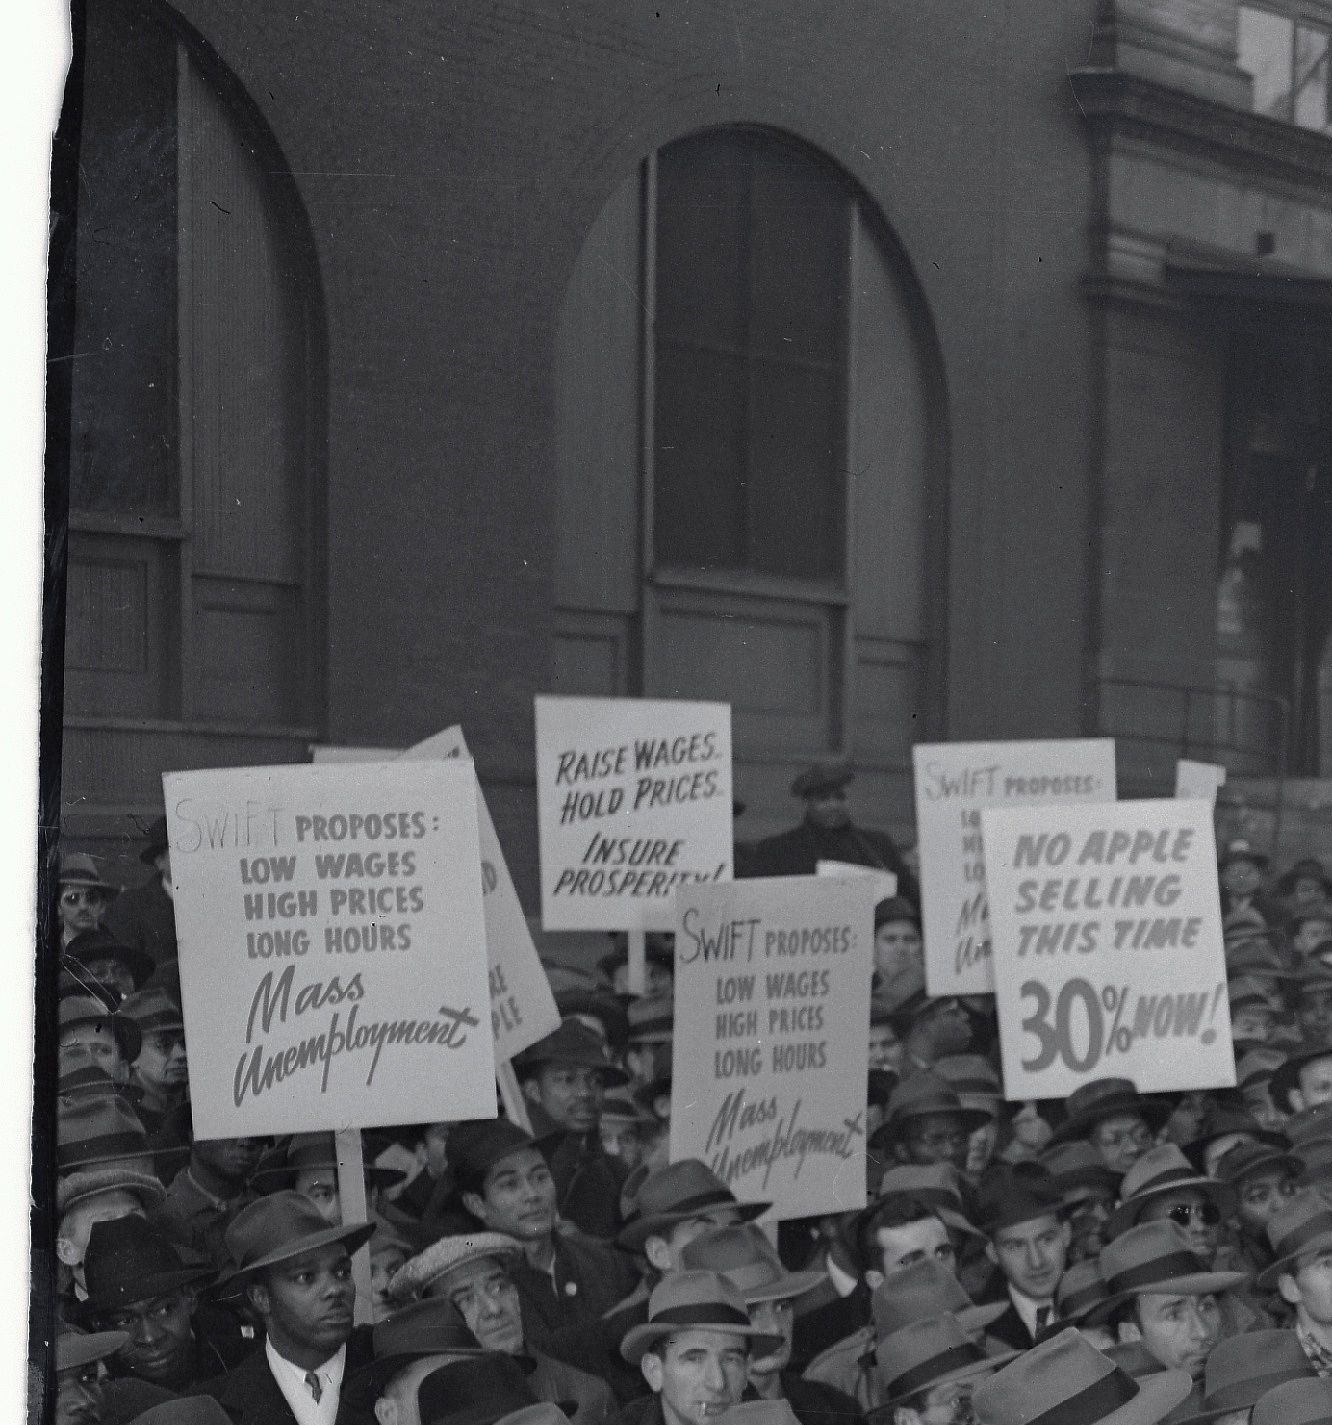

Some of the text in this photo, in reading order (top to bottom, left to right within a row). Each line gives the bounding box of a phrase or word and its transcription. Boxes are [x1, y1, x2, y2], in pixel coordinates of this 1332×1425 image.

[555, 745, 628, 786] RAISE
[926, 762, 1001, 799] SWIFT
[175, 798, 439, 853] SWIFT PROPOSES:
[560, 787, 625, 825] HOLD
[240, 851, 416, 884] LOW WAGES
[582, 831, 686, 866] INSURE
[1013, 832, 1072, 869] NO
[1077, 828, 1195, 866] APPLE
[244, 886, 424, 920] HIGH PRICES
[1014, 874, 1183, 914] SELLING
[247, 924, 412, 959] LONG HOURS
[679, 908, 761, 963] SWIFT
[1017, 920, 1100, 958] THIS
[1114, 916, 1202, 950] TIME
[246, 965, 365, 1043] Mass
[716, 969, 830, 1005] LOW WAGES
[716, 1005, 824, 1039] HIGH PRICES
[1020, 977, 1132, 1074] 30%
[234, 1004, 480, 1107] Unemployment
[715, 1042, 827, 1079] LONG HOURS
[705, 1088, 777, 1154] Mass
